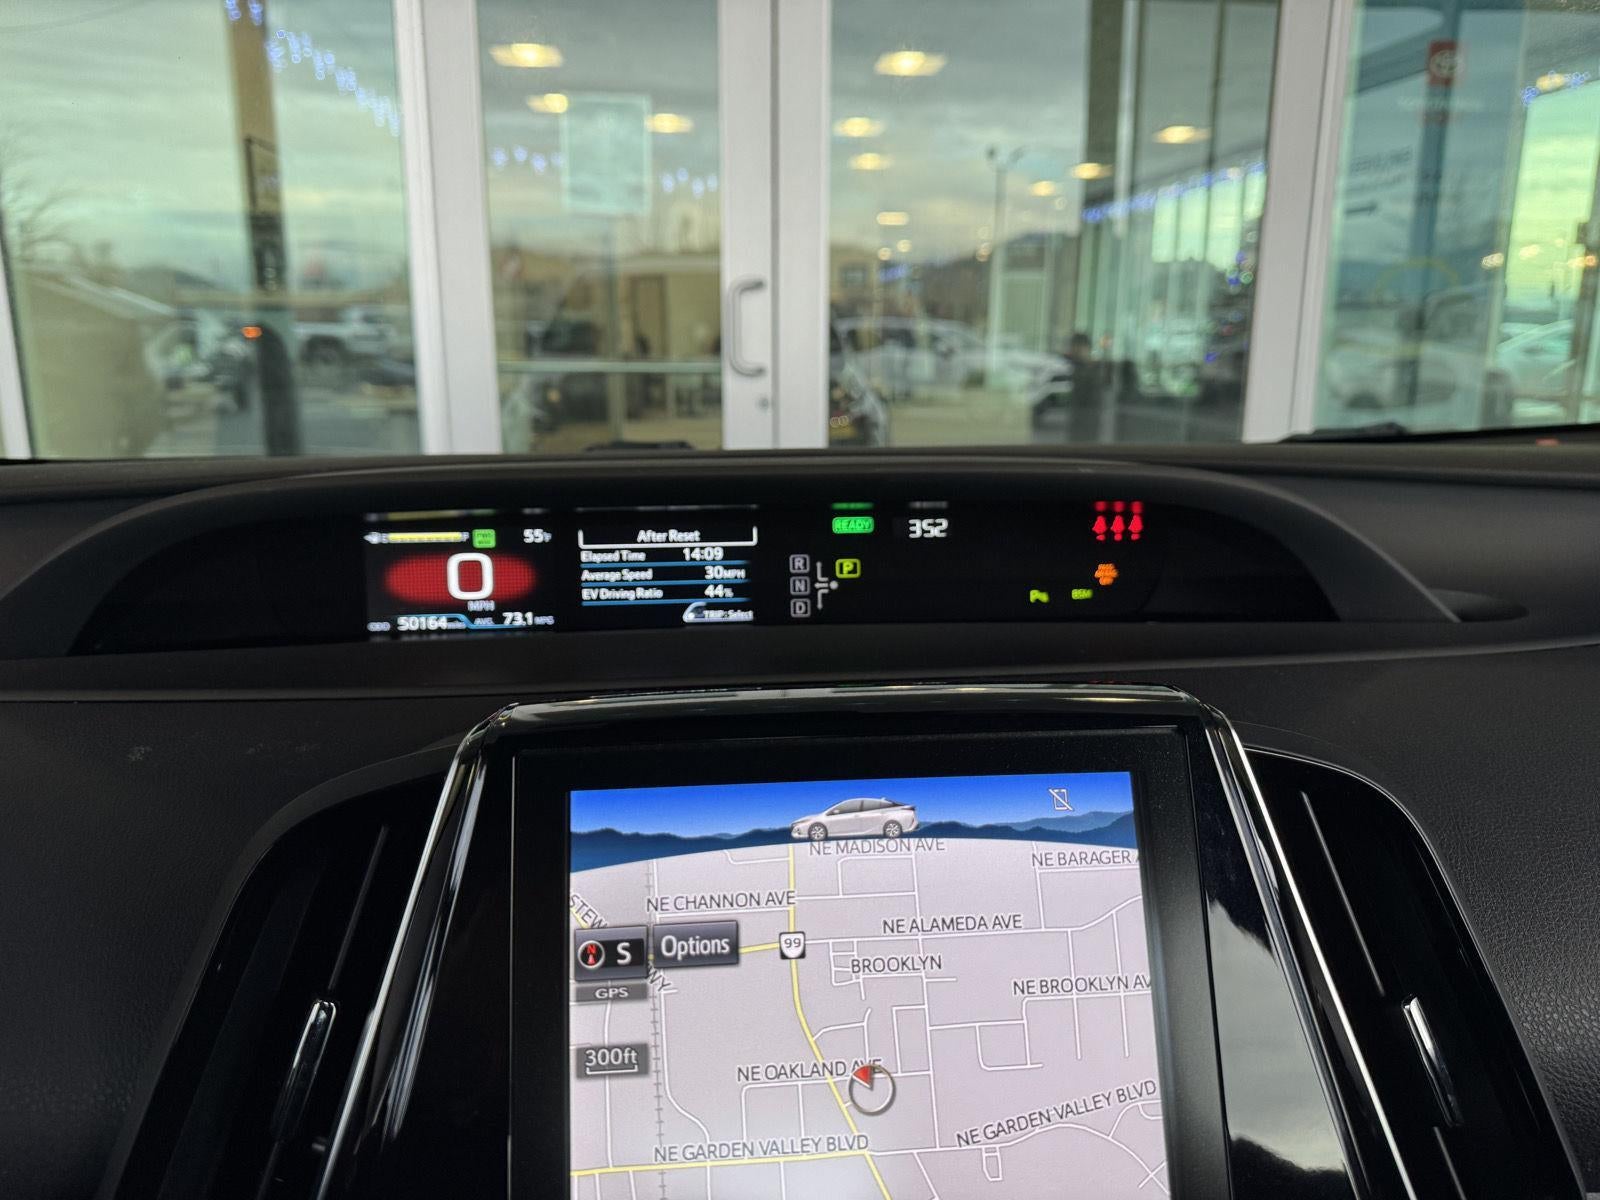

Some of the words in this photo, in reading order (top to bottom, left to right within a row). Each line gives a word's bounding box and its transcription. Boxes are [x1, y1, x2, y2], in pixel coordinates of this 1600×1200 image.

[834, 519, 872, 531] READY
[908, 518, 949, 538] 352
[637, 529, 667, 543] After
[668, 529, 701, 542] Reset
[580, 551, 620, 563] Elapsed
[621, 550, 646, 561] Time
[683, 547, 724, 561] 14:09
[794, 557, 805, 570] R
[842, 561, 855, 575] P
[447, 552, 494, 600] 0
[581, 569, 621, 582] Average
[621, 568, 653, 581] Speed
[581, 588, 599, 600] EV
[601, 587, 636, 600] Driving
[636, 586, 664, 599] Ratio
[795, 579, 806, 592] N
[467, 600, 496, 612] MPH
[795, 602, 807, 614] D
[397, 616, 447, 631] 50164
[809, 841, 830, 856] NE
[836, 839, 911, 854] MADISON
[912, 838, 946, 852] AVE
[1032, 853, 1054, 867] NE
[1057, 850, 1132, 866] BARAGER
[646, 897, 670, 912] NE
[674, 894, 761, 910] CHANNON
[765, 891, 796, 906] AVE
[883, 919, 905, 934] NE
[908, 916, 989, 933] ALAMEDA
[991, 914, 1023, 930] AVE
[660, 935, 731, 961] Options
[783, 937, 801, 949] 99
[616, 941, 632, 966] S
[851, 956, 942, 974] BROOKLYN
[594, 987, 629, 999] GPS
[1013, 980, 1036, 996] NE
[1039, 976, 1129, 994] BROOKLYN
[1133, 974, 1151, 989] AV
[585, 1047, 638, 1067] 300ft
[737, 1066, 761, 1082] NE
[764, 1061, 848, 1081] OAKLAND
[955, 1128, 982, 1148] NE
[983, 1109, 1052, 1140] GARDEN
[1052, 1091, 1113, 1120] VALLEY
[1115, 1079, 1158, 1104] BLVD
[654, 1146, 678, 1163] NE
[682, 1142, 754, 1160] GARDEN
[758, 1137, 823, 1156] VALLEY
[826, 1134, 869, 1152] BLVD
